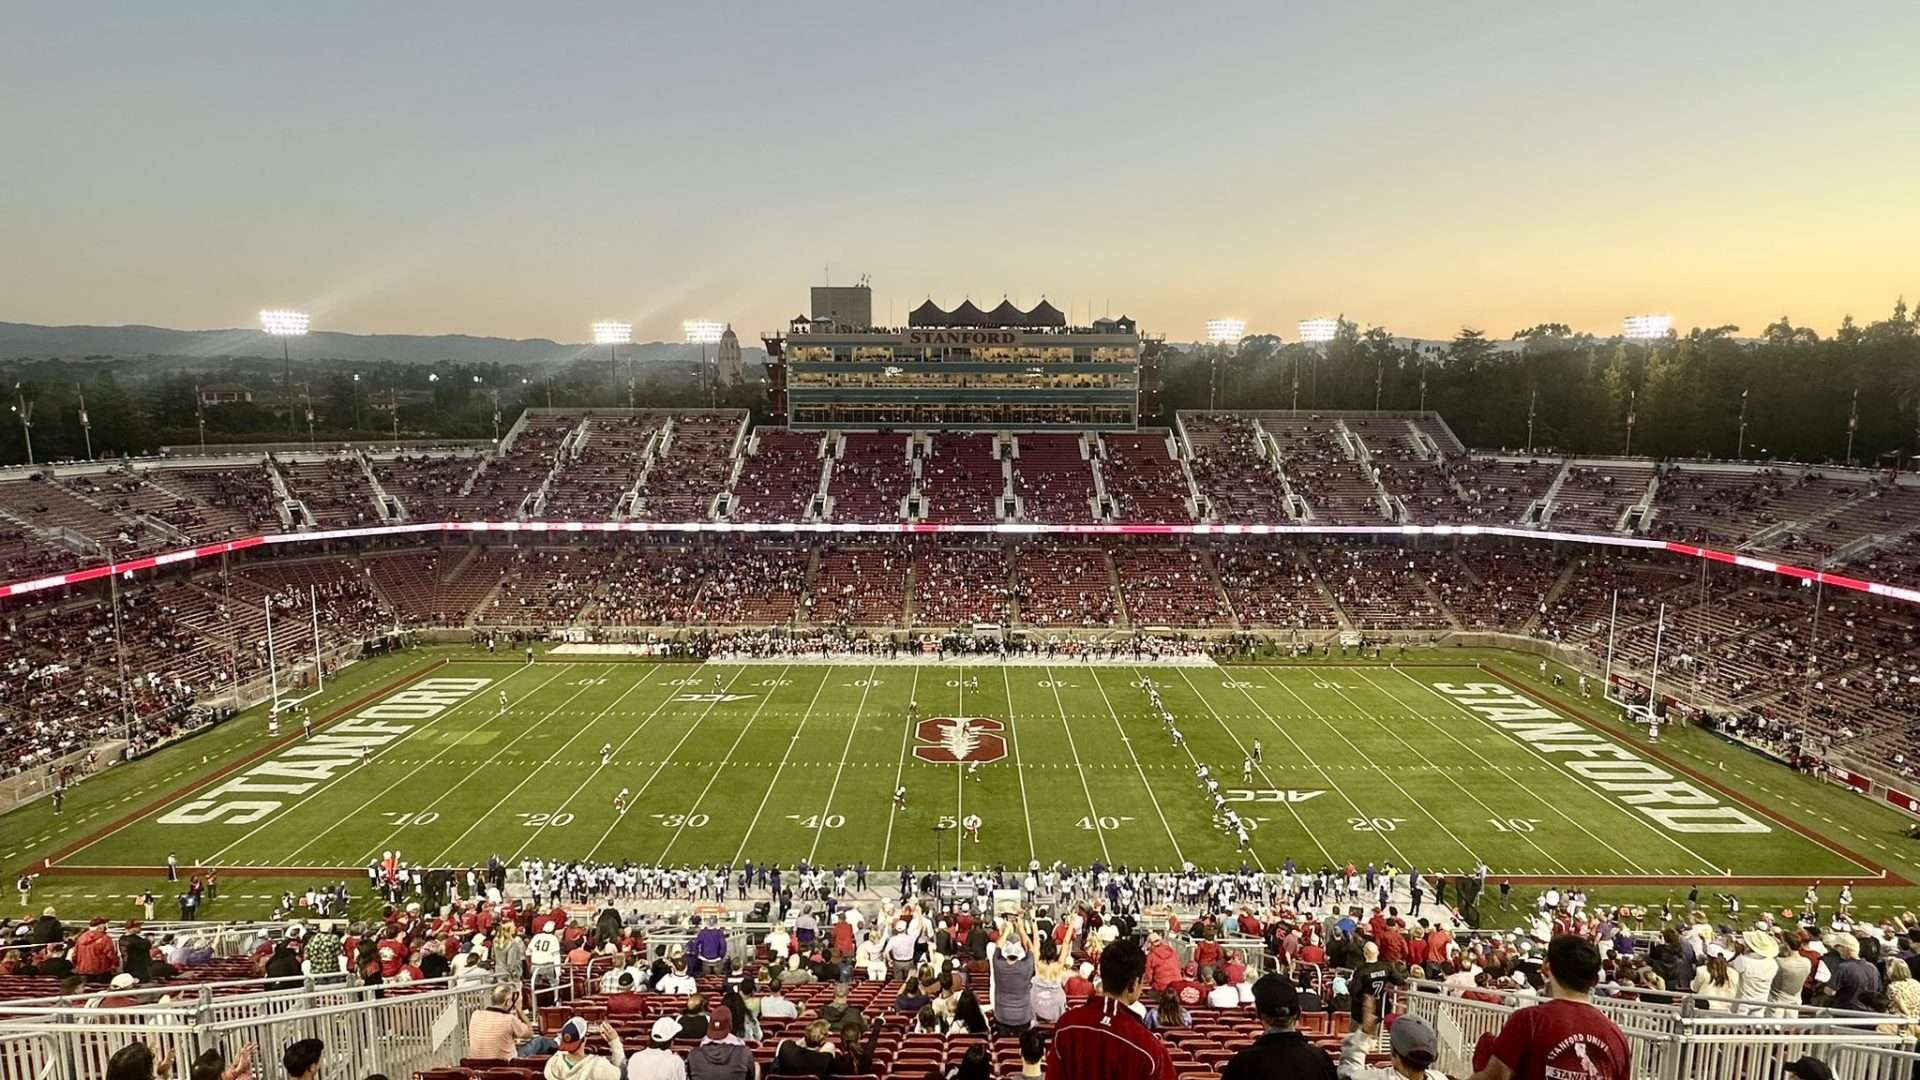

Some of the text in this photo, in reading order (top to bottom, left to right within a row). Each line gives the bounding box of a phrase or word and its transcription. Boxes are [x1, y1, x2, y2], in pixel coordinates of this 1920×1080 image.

[910, 331, 1016, 345] STANFORD
[157, 677, 492, 825] STANFORD
[1432, 681, 1773, 834] STANFORD
[389, 812, 440, 826] 10
[522, 813, 575, 827] 20
[662, 813, 710, 828] 30
[800, 814, 846, 829] 40
[1075, 815, 1120, 830] 40
[1346, 817, 1396, 832] 20
[1488, 817, 1535, 832] 10
[534, 939, 550, 952] 40
[1372, 980, 1384, 999] 7
[1547, 1033, 1585, 1060] STANFORD
